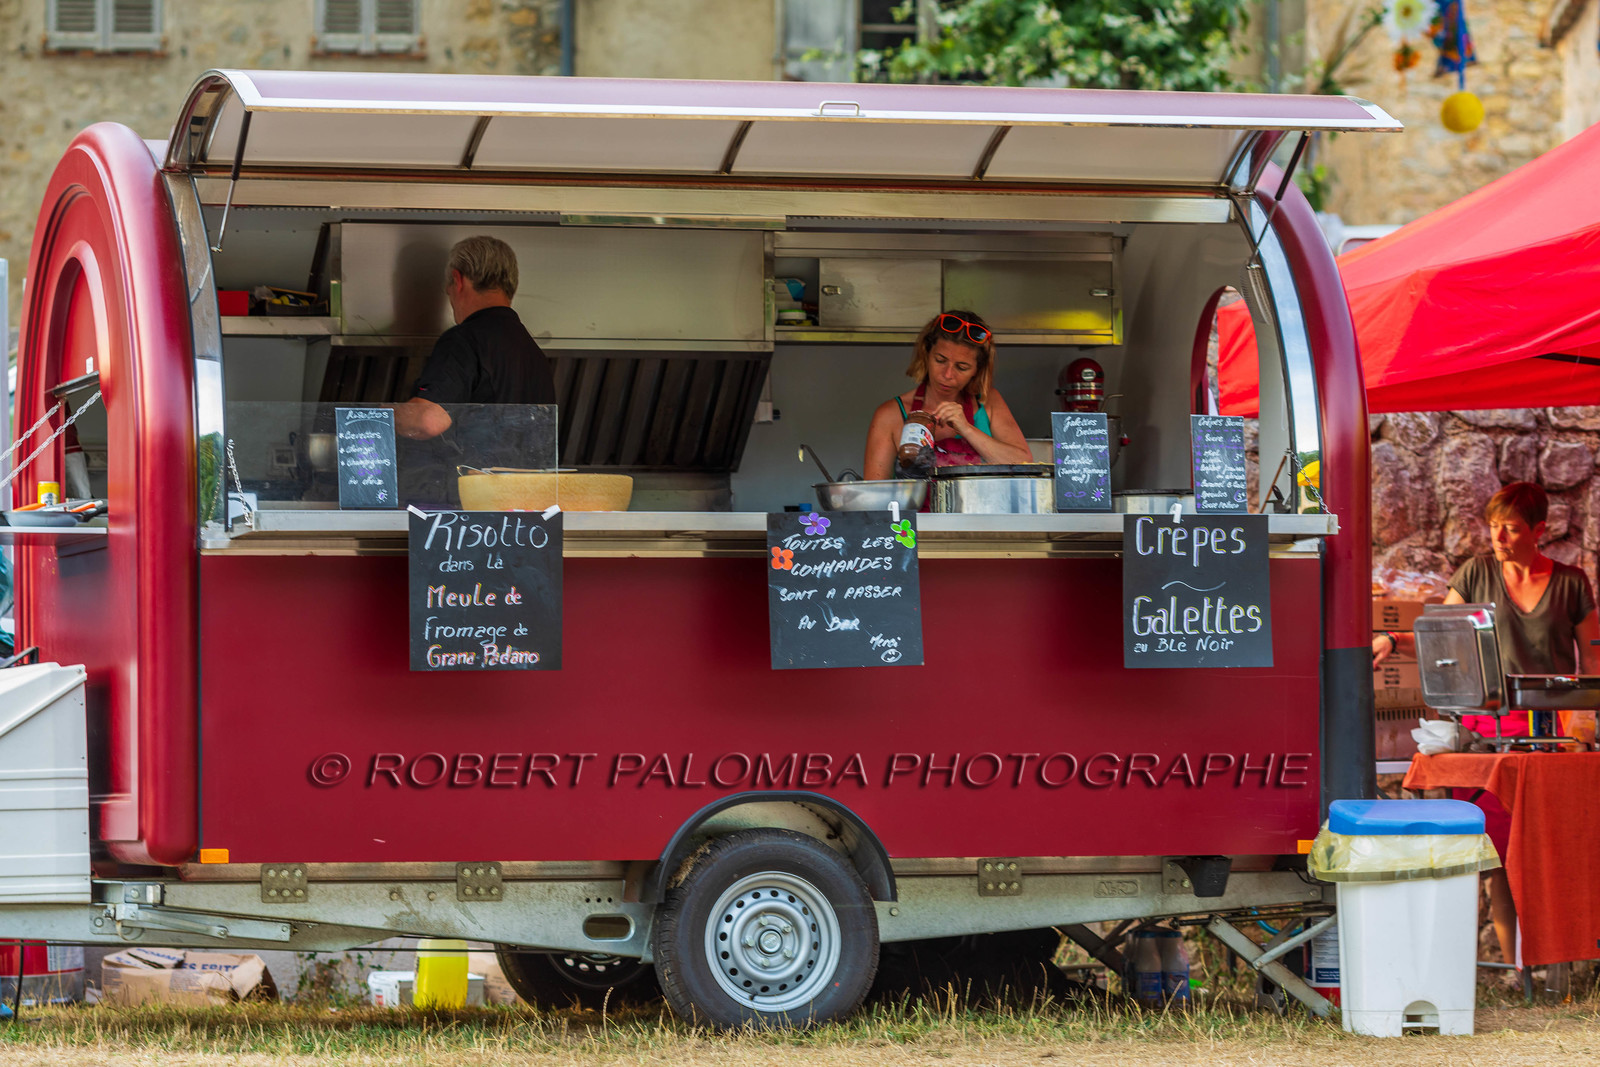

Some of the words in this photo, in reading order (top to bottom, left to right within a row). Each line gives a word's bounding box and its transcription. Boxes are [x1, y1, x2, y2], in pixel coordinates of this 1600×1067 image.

[424, 512, 549, 551] Risotto
[782, 534, 845, 551] TOUTES
[862, 536, 895, 549] LES
[439, 554, 474, 572] dans
[790, 556, 893, 578] COMMANDES
[504, 586, 523, 606] de
[779, 588, 818, 602] SONT
[826, 588, 837, 599] A
[844, 585, 902, 600] PASSER
[1132, 596, 1263, 636] Galettes
[424, 616, 507, 646] Fromage
[513, 622, 529, 637] de
[1133, 642, 1149, 653] au
[1195, 635, 1235, 652] Noir
[426, 644, 476, 668] Grana
[481, 643, 541, 668] Padano
